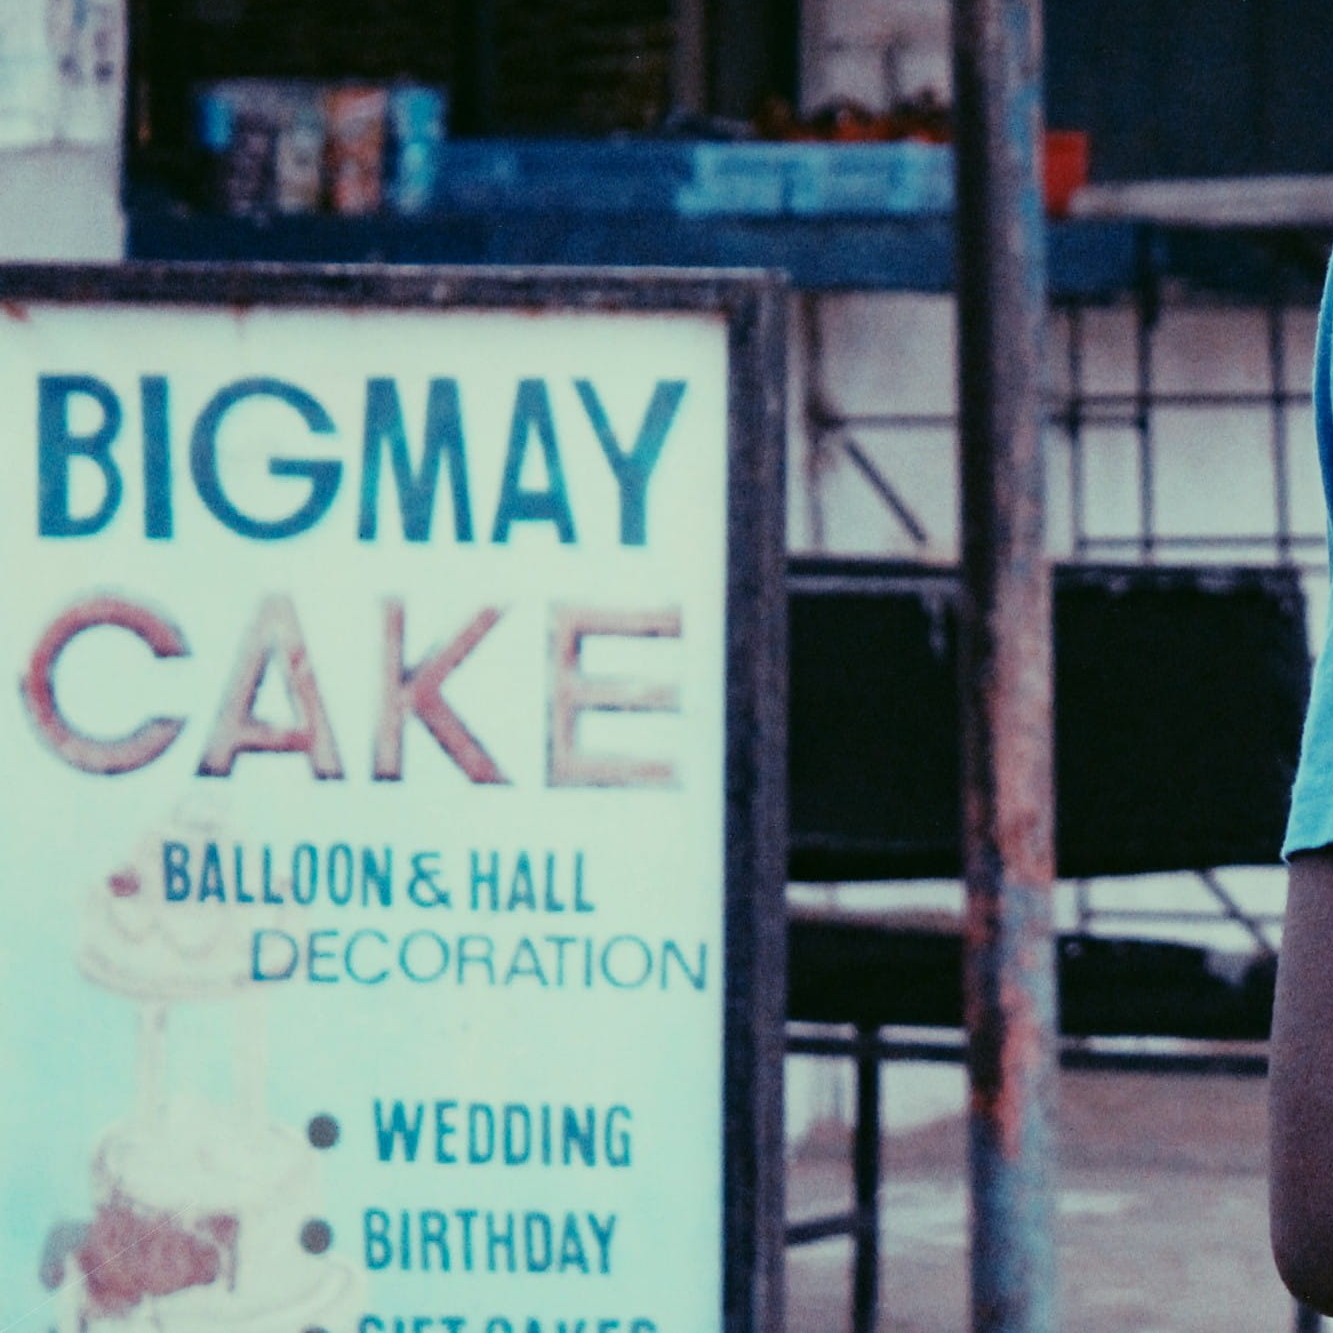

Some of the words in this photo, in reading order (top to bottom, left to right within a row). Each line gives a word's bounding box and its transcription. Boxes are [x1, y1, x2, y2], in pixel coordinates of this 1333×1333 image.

[22, 593, 684, 789] CAKE
[161, 839, 394, 909] BALLOON
[406, 850, 452, 910] &
[469, 847, 597, 915] HALL
[250, 928, 709, 992] DECORATION
[372, 1097, 636, 1169] WEDDING
[362, 1206, 618, 1274] BIRTHDAY
